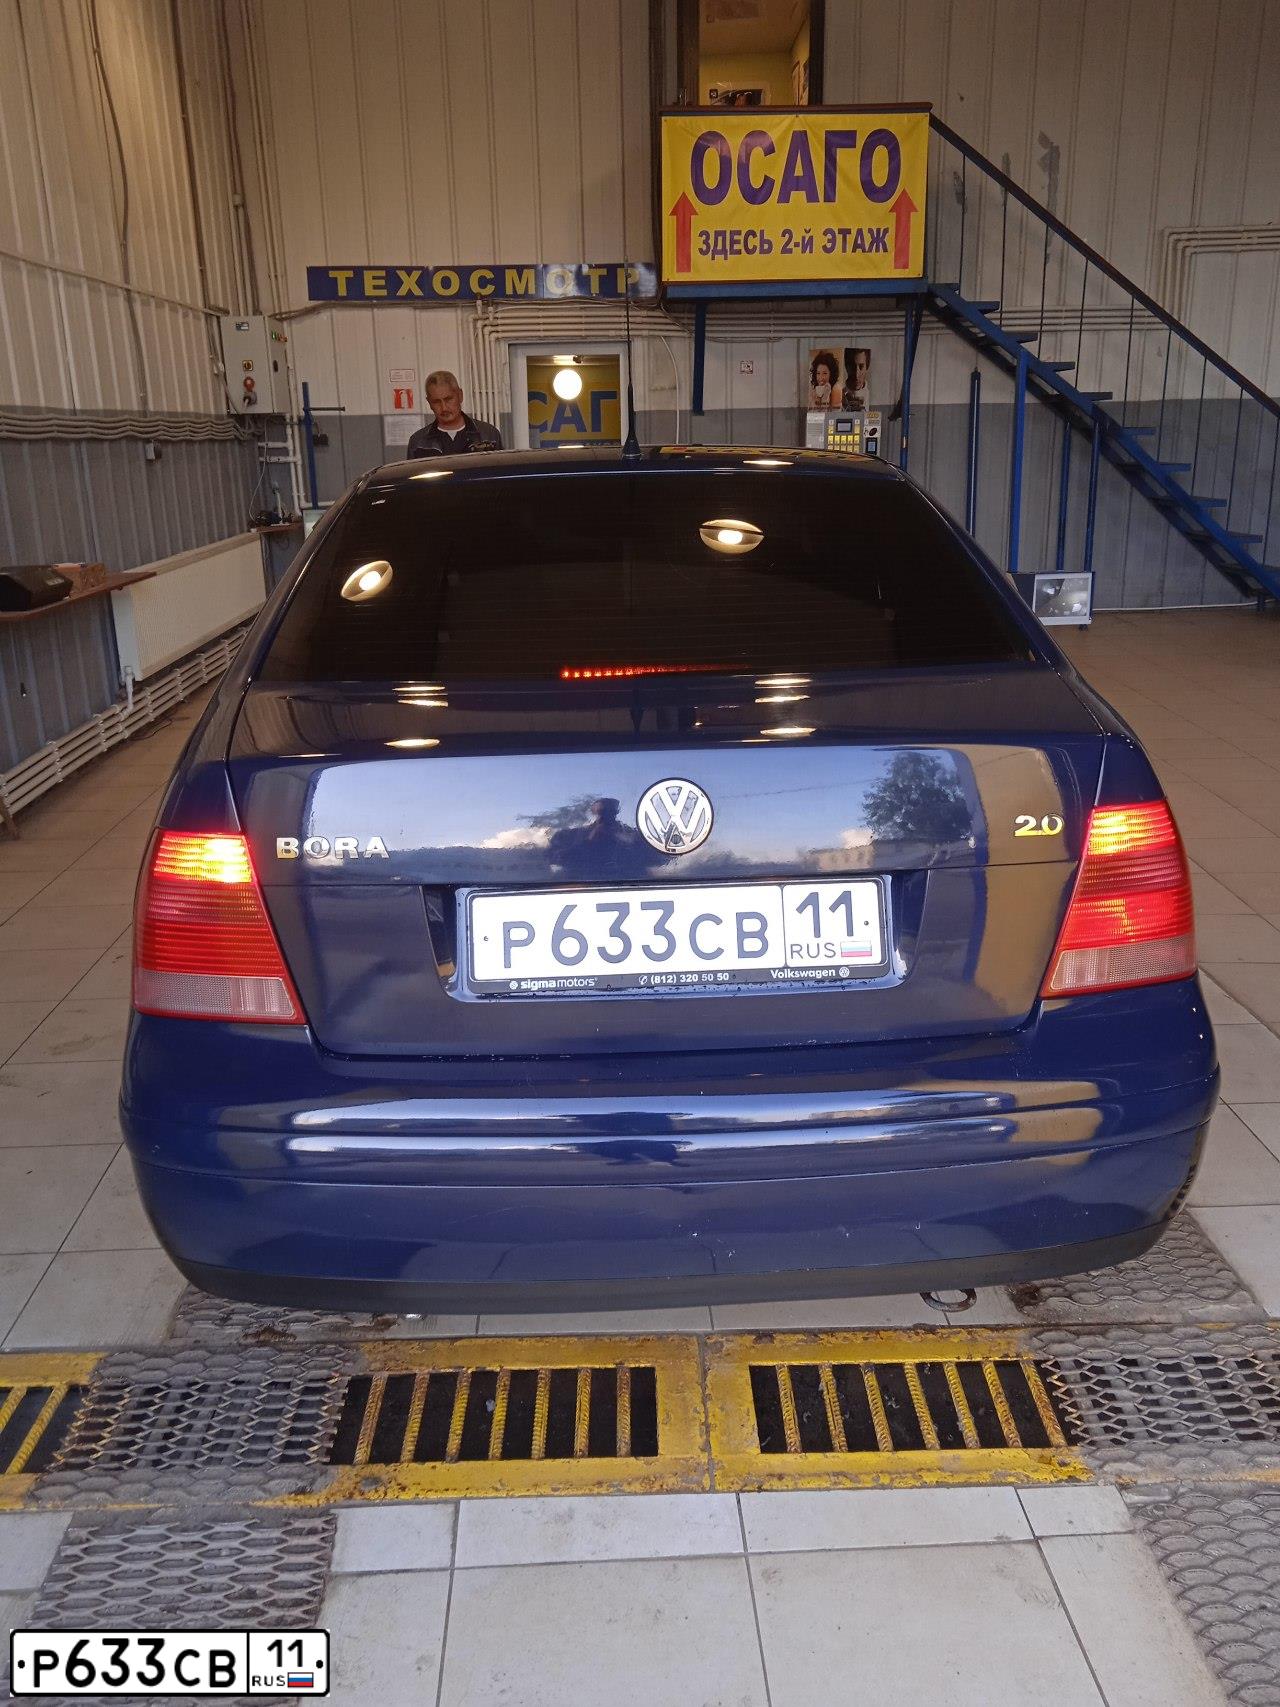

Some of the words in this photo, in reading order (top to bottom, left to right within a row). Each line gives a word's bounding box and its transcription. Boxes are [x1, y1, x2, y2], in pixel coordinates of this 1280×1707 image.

[690, 128, 902, 206] ОСАГО
[698, 229, 773, 260] ЗДЕСЬ
[780, 228, 815, 255] 2-й
[821, 227, 890, 254] ЭТАЖ
[328, 266, 641, 297] ТЕХОСМОТР
[276, 836, 390, 859] BORA
[795, 890, 854, 939] 11
[790, 942, 837, 960] RUS
[650, 974, 677, 985] (812)
[680, 973, 699, 983] 320
[702, 972, 714, 982] 50
[716, 972, 729, 982] 50
[770, 966, 836, 980] Volkswagen
